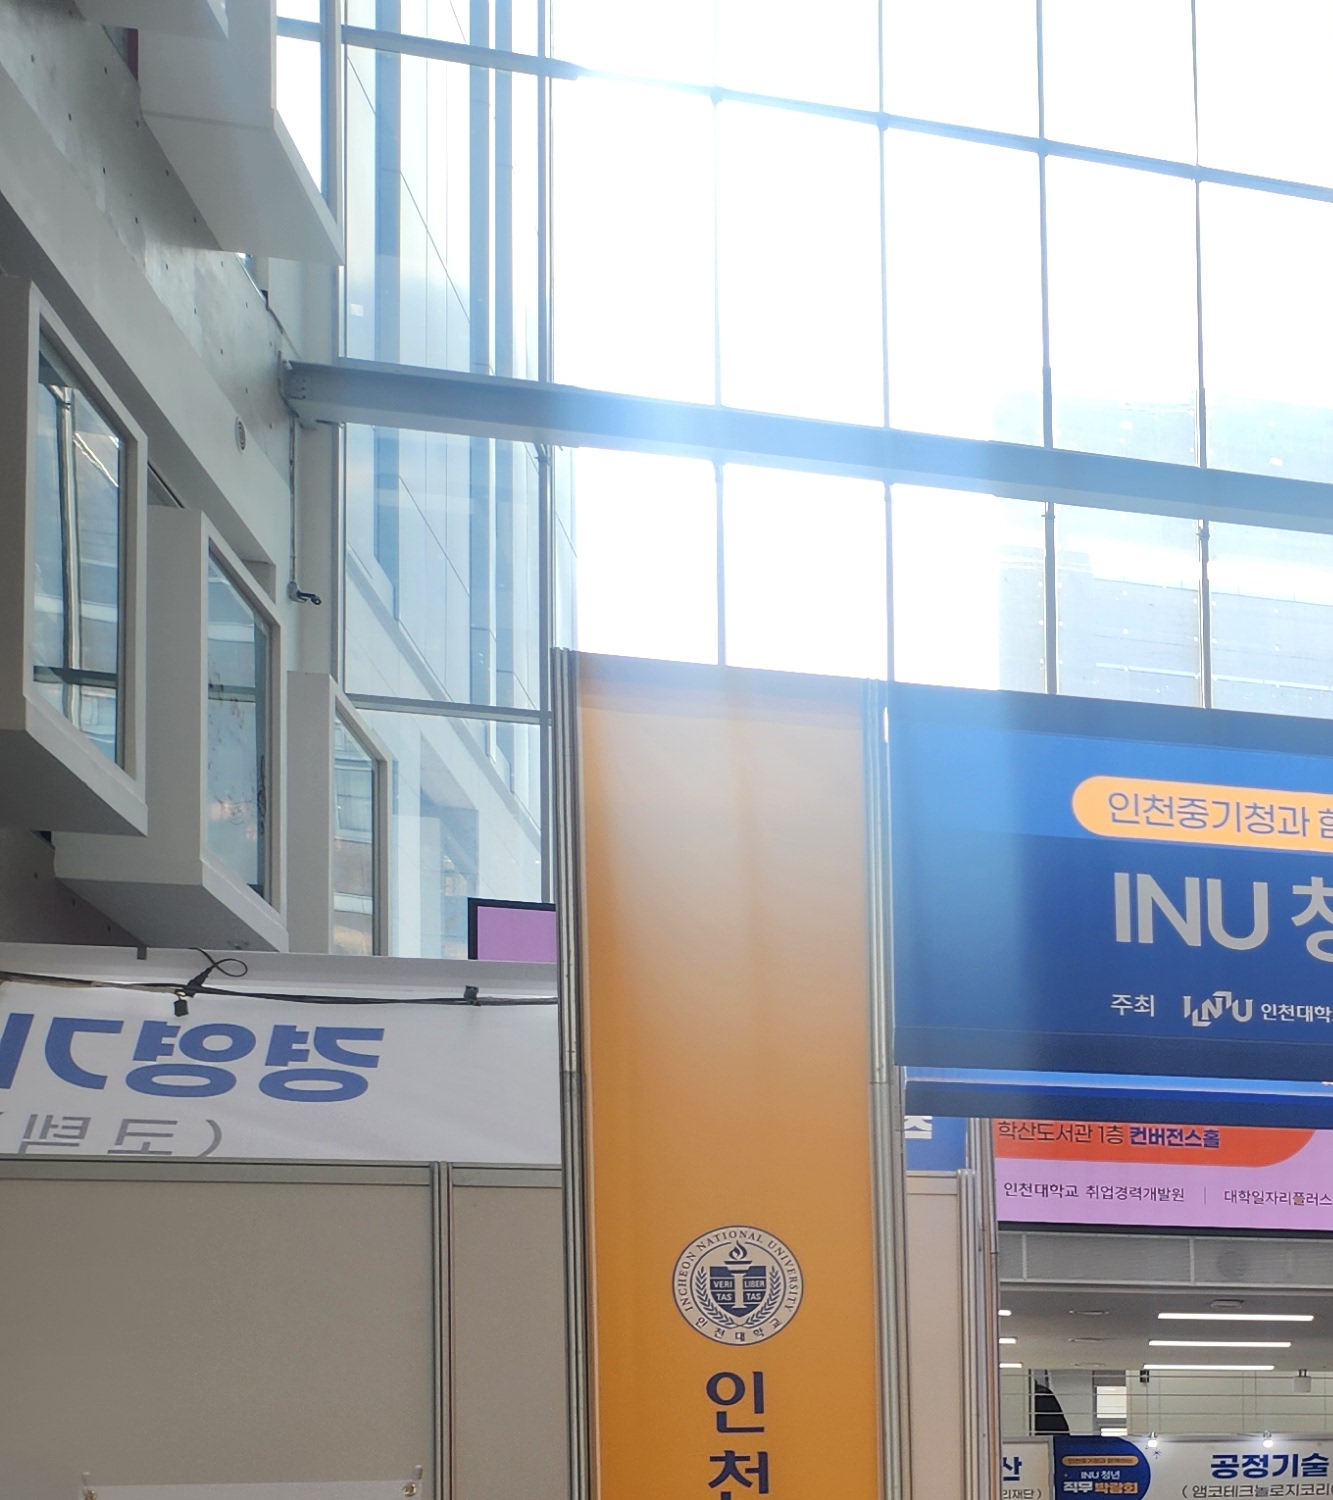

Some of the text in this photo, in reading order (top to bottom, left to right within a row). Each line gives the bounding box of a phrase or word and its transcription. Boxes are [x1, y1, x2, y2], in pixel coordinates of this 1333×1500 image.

[1107, 792, 1309, 837] 인천중기청과
[1114, 873, 1269, 950] INU
[1110, 994, 1155, 1017] 주최
[998, 1122, 1220, 1148] 학산도서관 1층 컨버전스홀
[1003, 1181, 1079, 1198] 인천대학교
[1086, 1184, 1185, 1202] 취업경력개발원
[678, 1230, 798, 1312] INCHEON NATIONAL UNIVERSITY
[1081, 1471, 1099, 1479] INU
[1210, 1453, 1330, 1479] 공정기술
[1064, 1482, 1092, 1493] 직무
